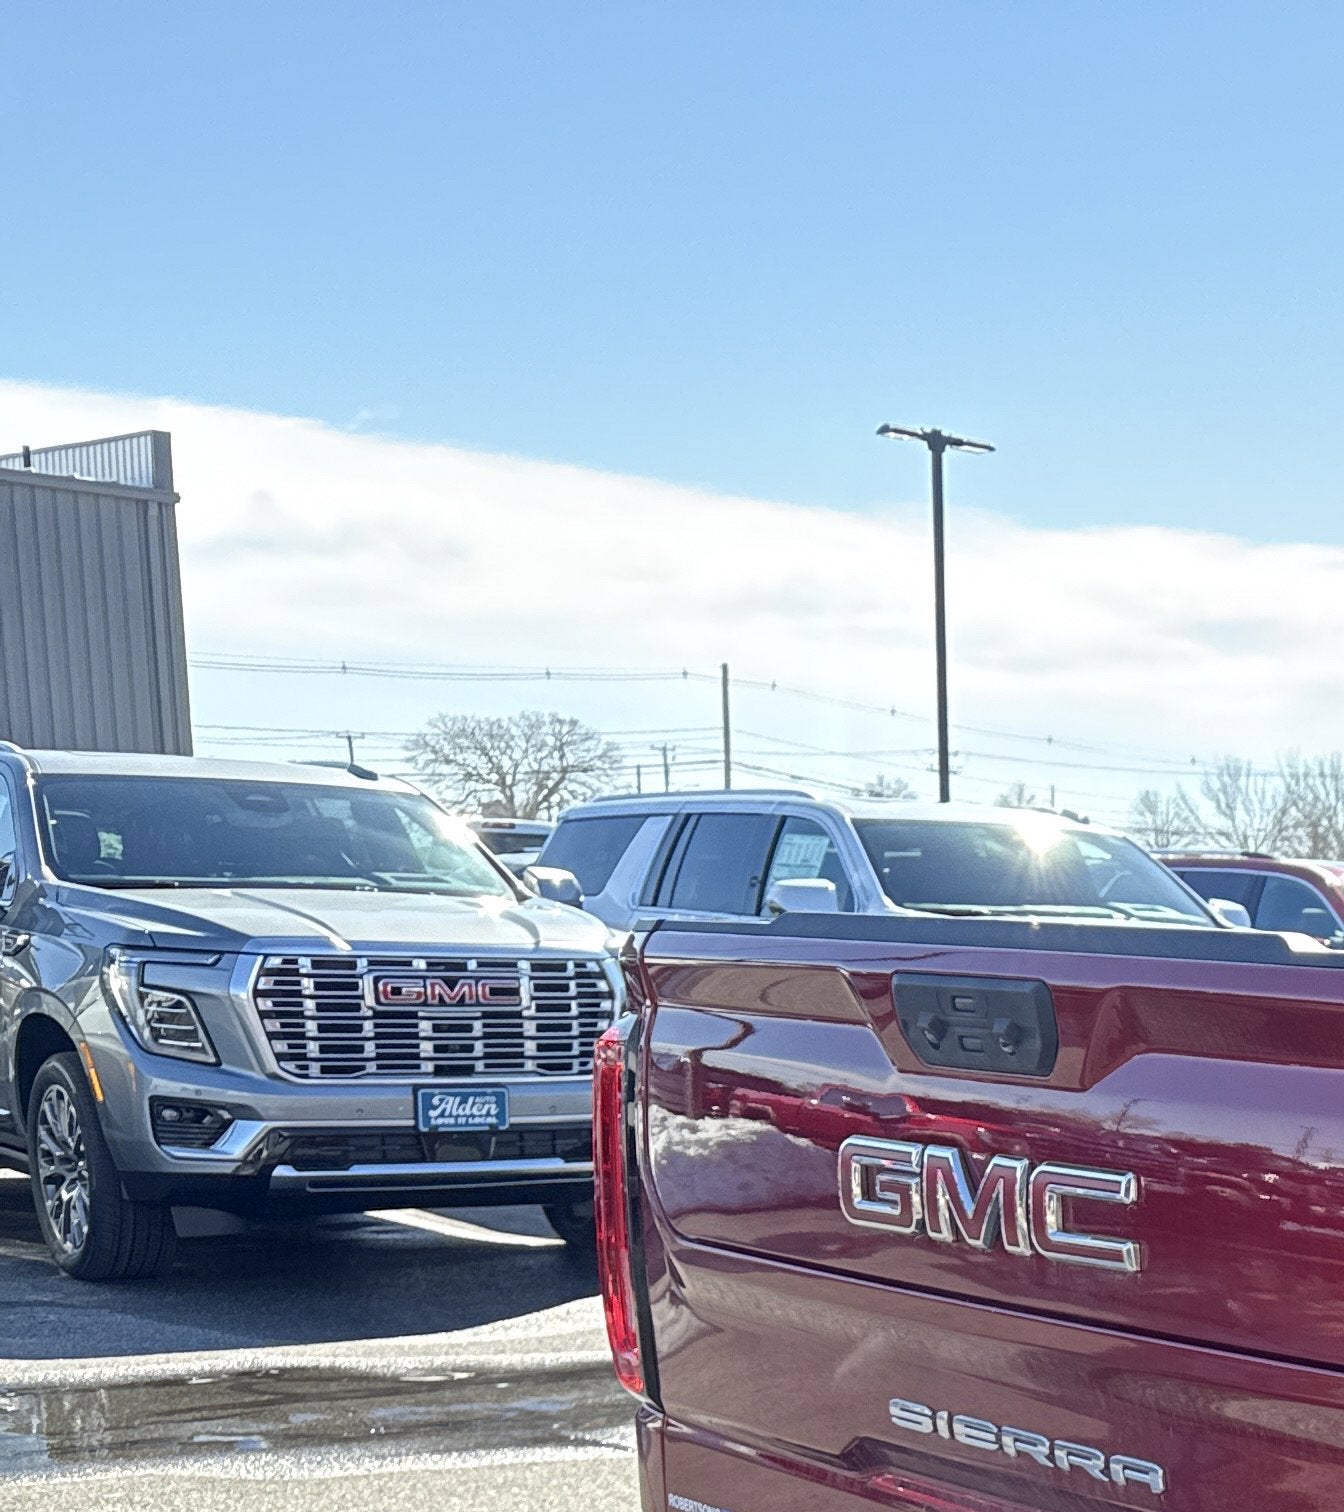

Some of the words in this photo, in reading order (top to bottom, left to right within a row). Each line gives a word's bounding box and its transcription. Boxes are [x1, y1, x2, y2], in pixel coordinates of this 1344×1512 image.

[378, 978, 521, 1005] GMC
[428, 1095, 500, 1117] Alden
[838, 1134, 1142, 1272] GMC
[889, 1398, 1166, 1494] SIERRA
